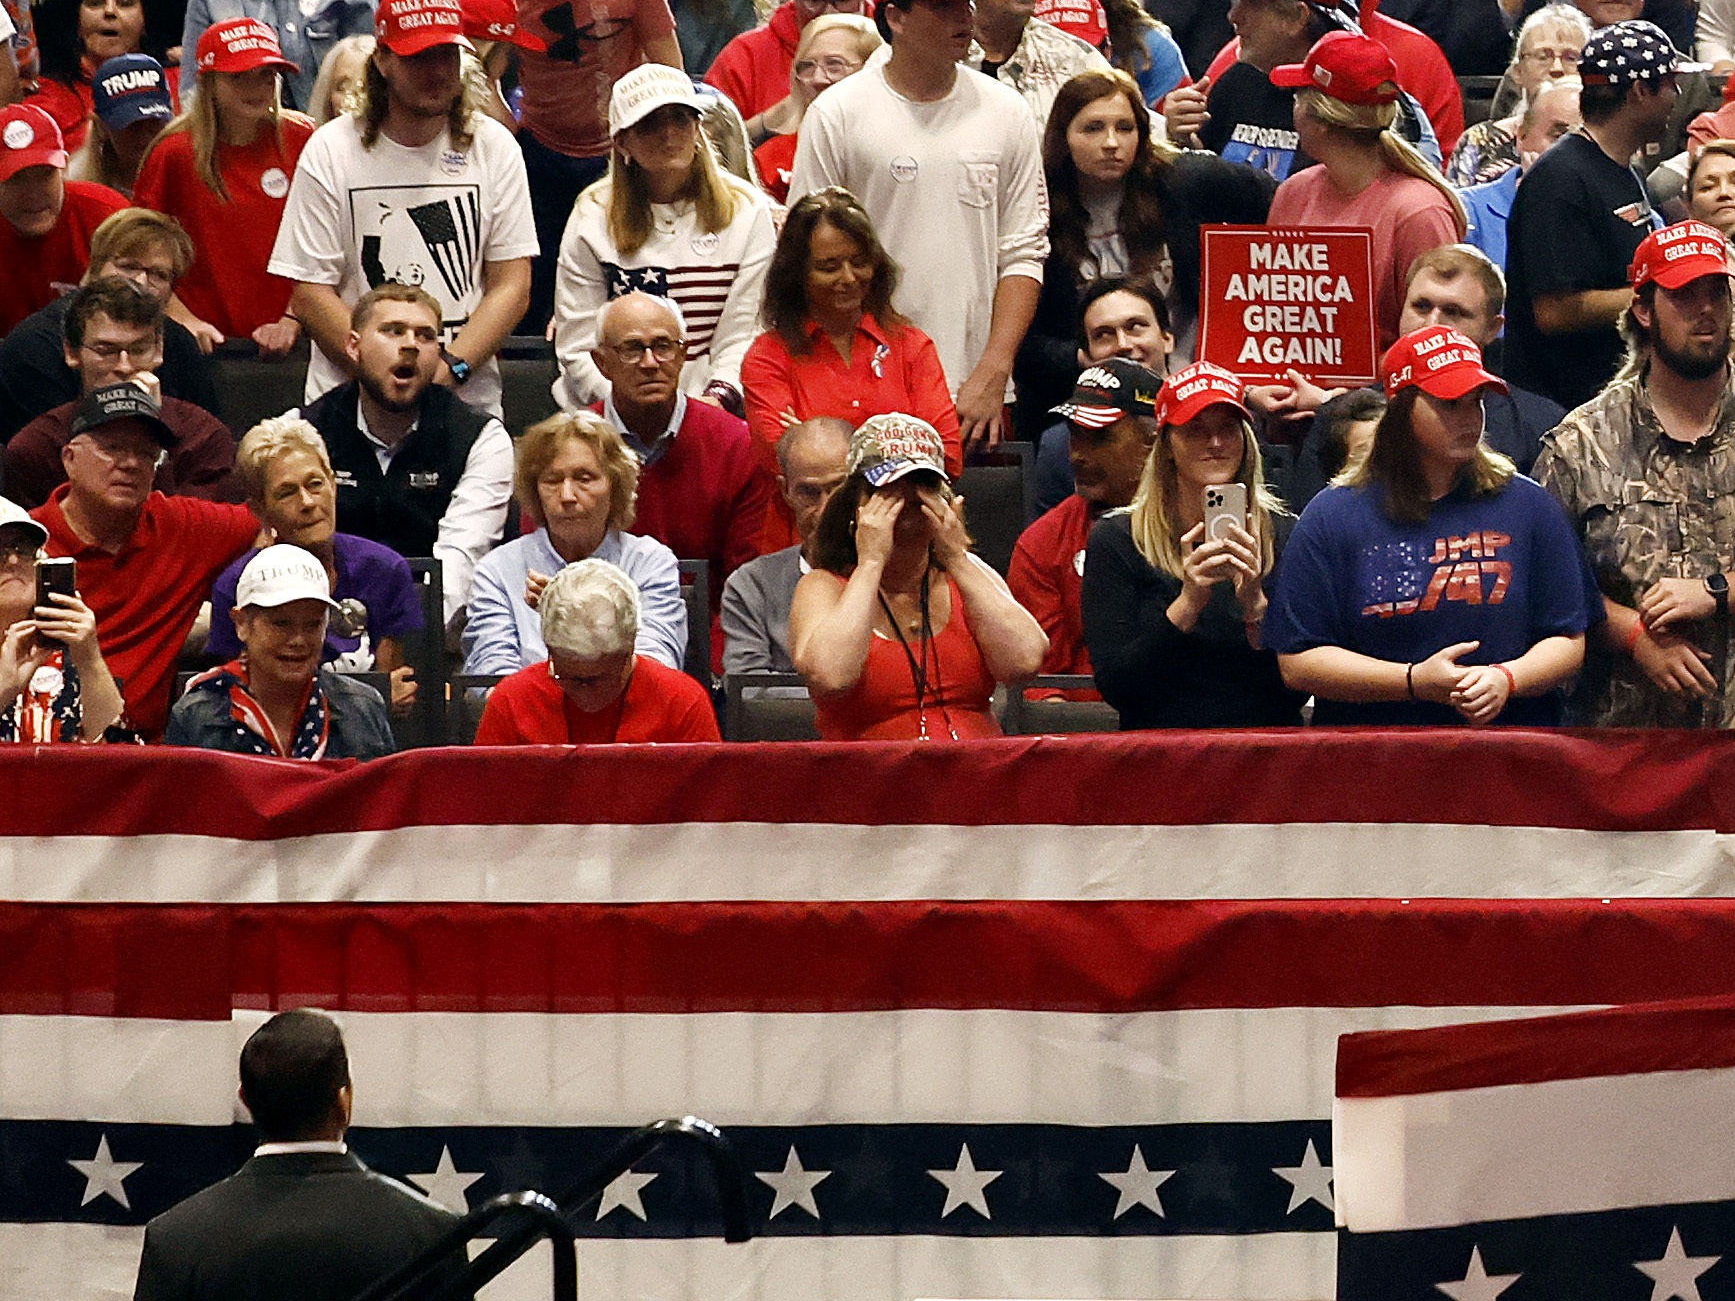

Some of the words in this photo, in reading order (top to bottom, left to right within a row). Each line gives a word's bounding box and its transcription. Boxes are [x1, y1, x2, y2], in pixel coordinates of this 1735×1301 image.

[390, 0, 422, 15] MAKE
[1061, 10, 1090, 24] AGAIN
[399, 13, 430, 30] GREAT
[430, 11, 460, 26] AGAIN
[218, 25, 248, 42] MAKE
[227, 37, 256, 53] GREAT
[102, 70, 160, 96] TRUMP
[1655, 227, 1689, 246] MAKE
[1249, 242, 1330, 271] MAKE
[1663, 243, 1701, 261] GREAT
[1224, 273, 1354, 303] AMERICA
[1242, 304, 1338, 334] GREAT
[1237, 336, 1343, 365] AGAIN!
[1412, 337, 1444, 356] MAKE
[1426, 352, 1460, 371] GREAT
[1168, 370, 1199, 389] MAKE
[96, 387, 126, 403] MAKE
[1176, 381, 1208, 400] GREAT
[103, 400, 138, 415] GREAT
[258, 564, 325, 582] TRUMP
